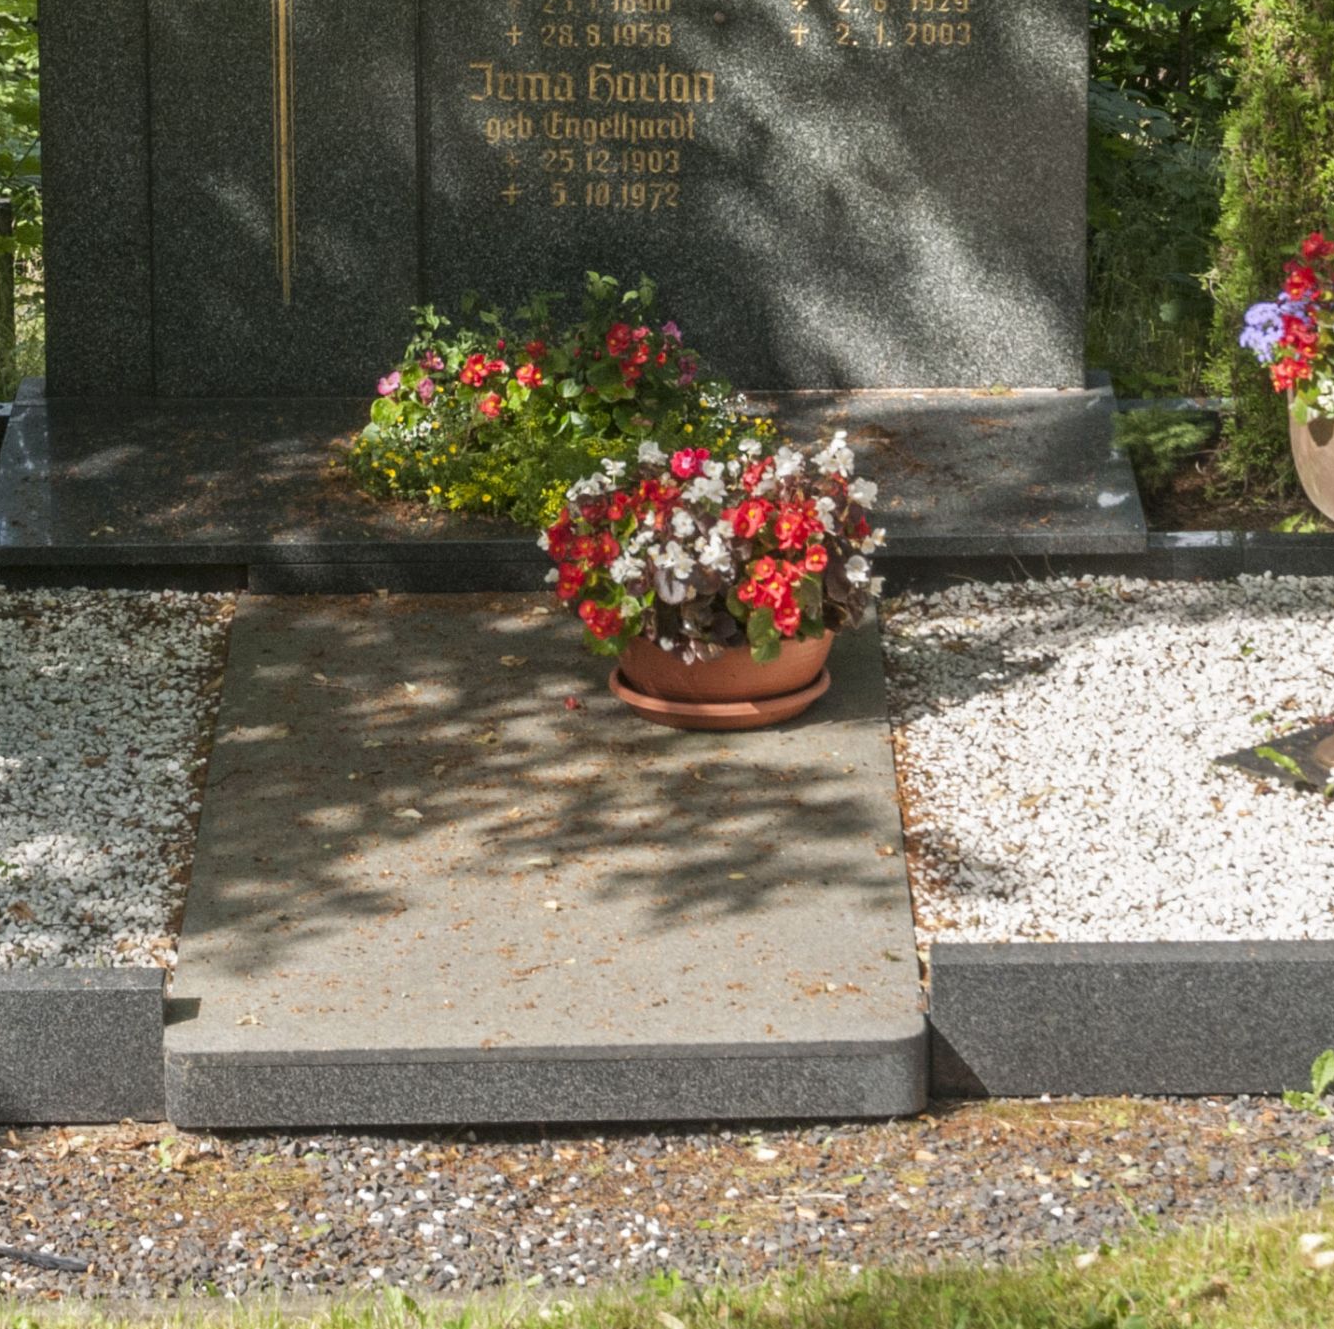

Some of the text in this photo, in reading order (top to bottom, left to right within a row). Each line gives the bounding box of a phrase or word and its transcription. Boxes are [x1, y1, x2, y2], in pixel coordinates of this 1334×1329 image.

[469, 61, 715, 106] Irma Hartan
[543, 109, 696, 146] Engelhardt
